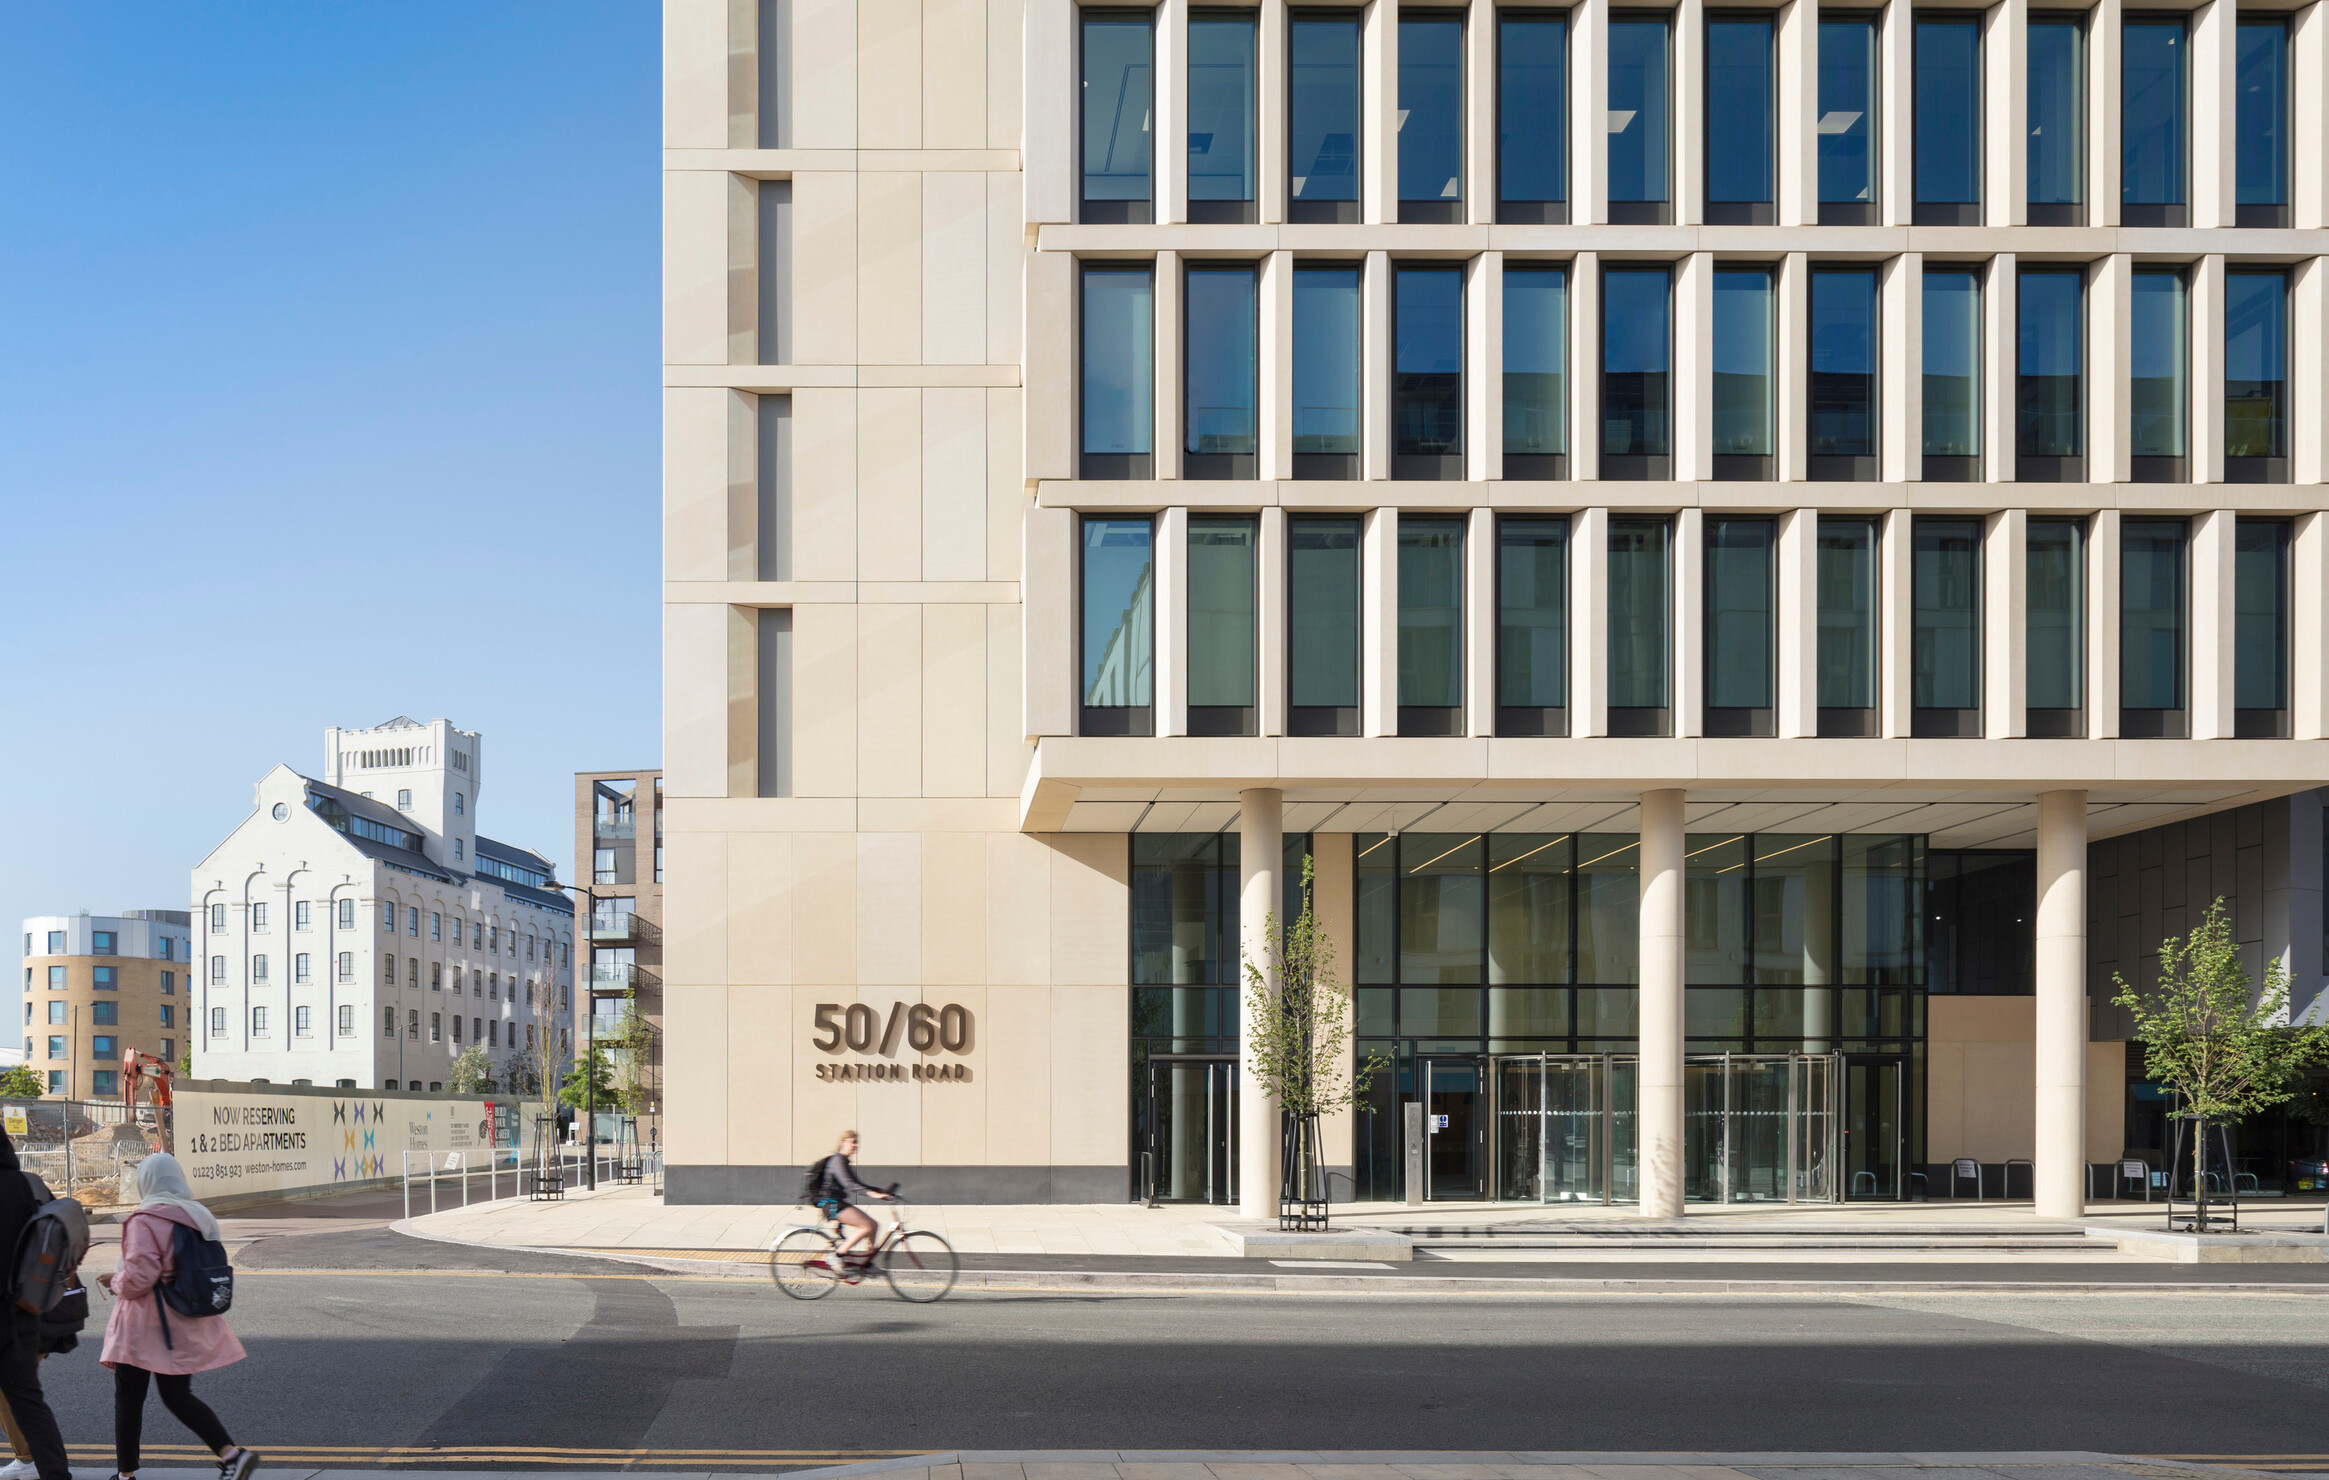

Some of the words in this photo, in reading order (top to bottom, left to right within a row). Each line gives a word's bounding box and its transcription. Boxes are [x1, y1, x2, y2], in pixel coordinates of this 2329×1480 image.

[813, 1001, 967, 1054] 50/60
[816, 1064, 900, 1079] STATION
[912, 1064, 964, 1079] ROAD
[213, 1106, 240, 1125] NOW
[243, 1107, 295, 1125] RESERVING
[409, 1122, 428, 1135] Weston
[191, 1138, 197, 1153] 1
[200, 1134, 208, 1153] &
[211, 1137, 217, 1152] 2
[220, 1133, 241, 1152] BED
[243, 1132, 306, 1151] APARTMENTS
[410, 1137, 428, 1150] Homes
[193, 1166, 214, 1179] 01223
[216, 1164, 228, 1179] 851
[229, 1165, 242, 1178] 923
[245, 1161, 306, 1174] weston-homes.com
